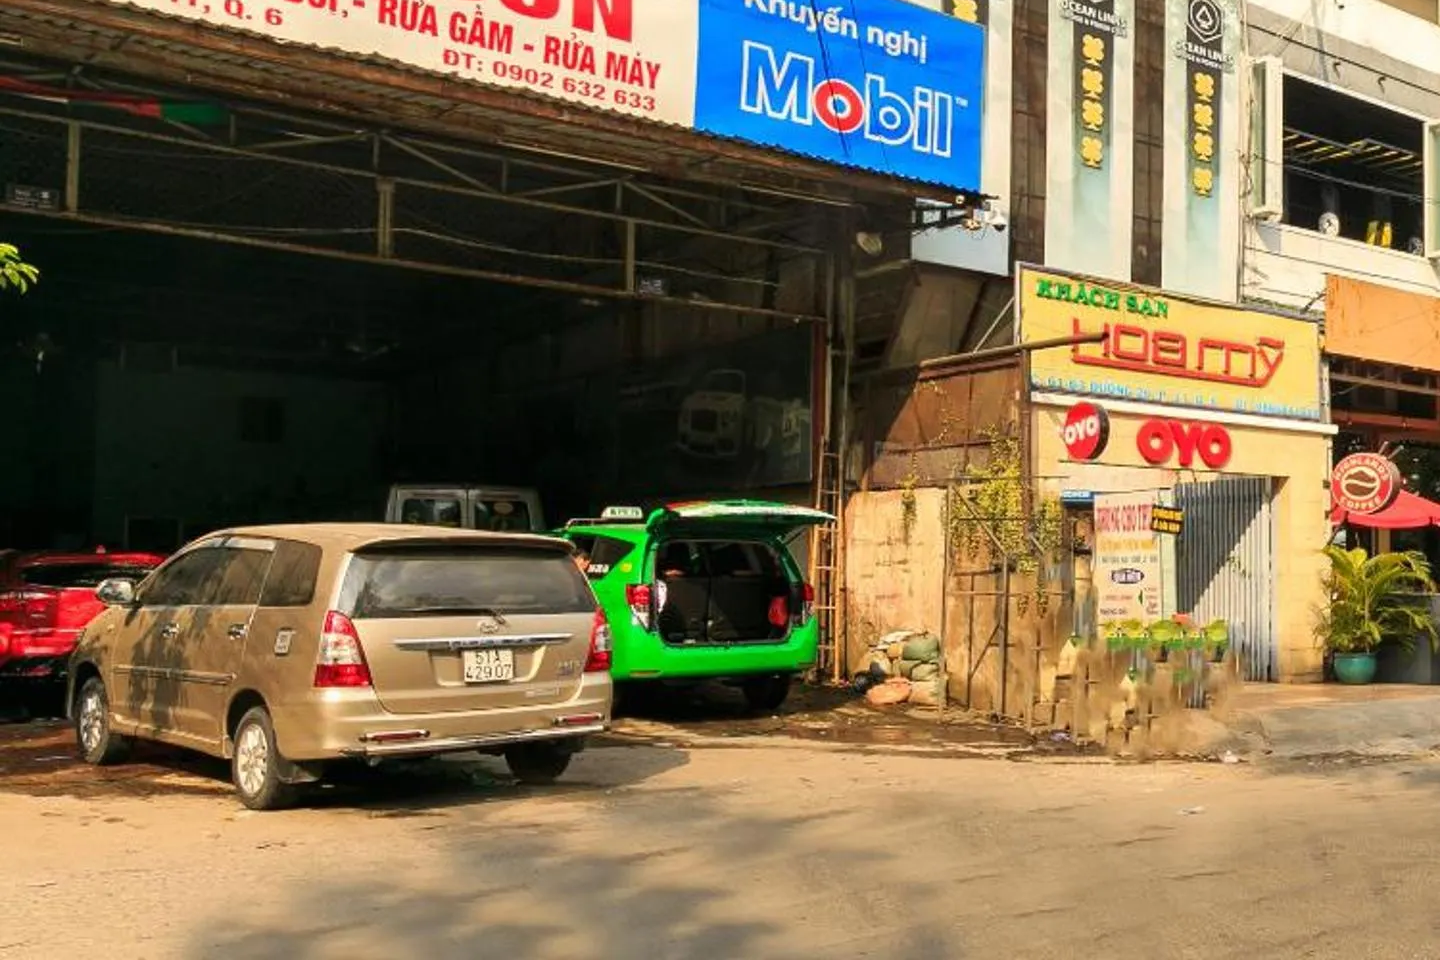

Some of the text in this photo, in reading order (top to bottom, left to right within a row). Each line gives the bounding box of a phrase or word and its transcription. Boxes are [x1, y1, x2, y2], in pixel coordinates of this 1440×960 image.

[263, 7, 285, 26] 6
[542, 31, 597, 76] RỬA
[604, 50, 662, 92] MÁY
[866, 23, 928, 65] nghị
[442, 47, 657, 112] ĐT: 0902 632 633
[739, 39, 952, 158] Mobil
[1065, 415, 1232, 469] OYO OYO
[1340, 494, 1382, 510] COFFEE
[475, 650, 501, 665] 51A
